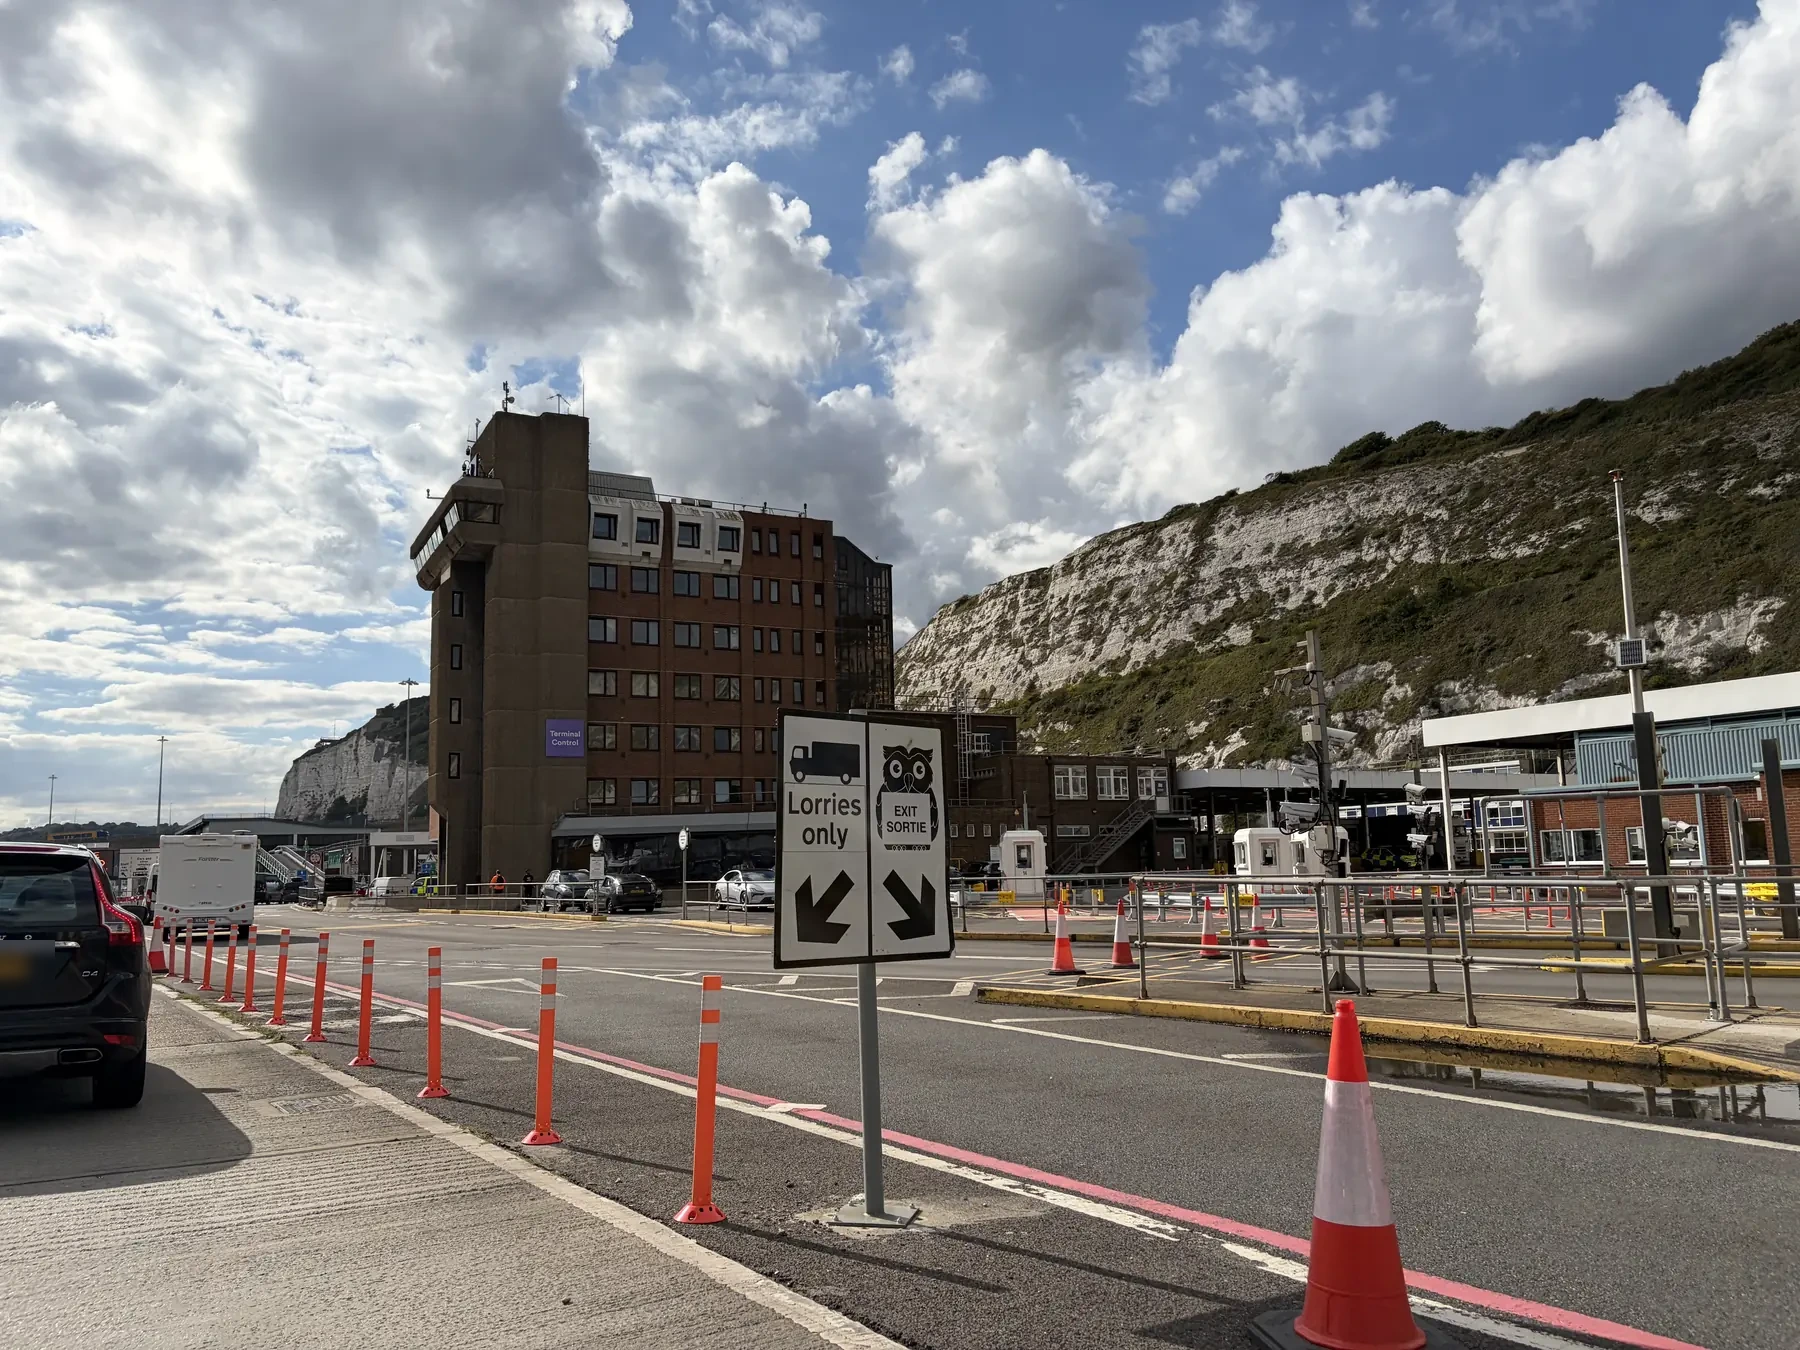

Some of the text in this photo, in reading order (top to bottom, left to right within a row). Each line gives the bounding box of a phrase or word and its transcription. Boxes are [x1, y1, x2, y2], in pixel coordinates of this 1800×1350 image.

[549, 730, 581, 738] Terminal
[551, 738, 579, 746] Control
[788, 791, 862, 816] Lorries
[894, 805, 918, 818] EXIT
[886, 821, 927, 833] SORTIE
[802, 822, 849, 850] only
